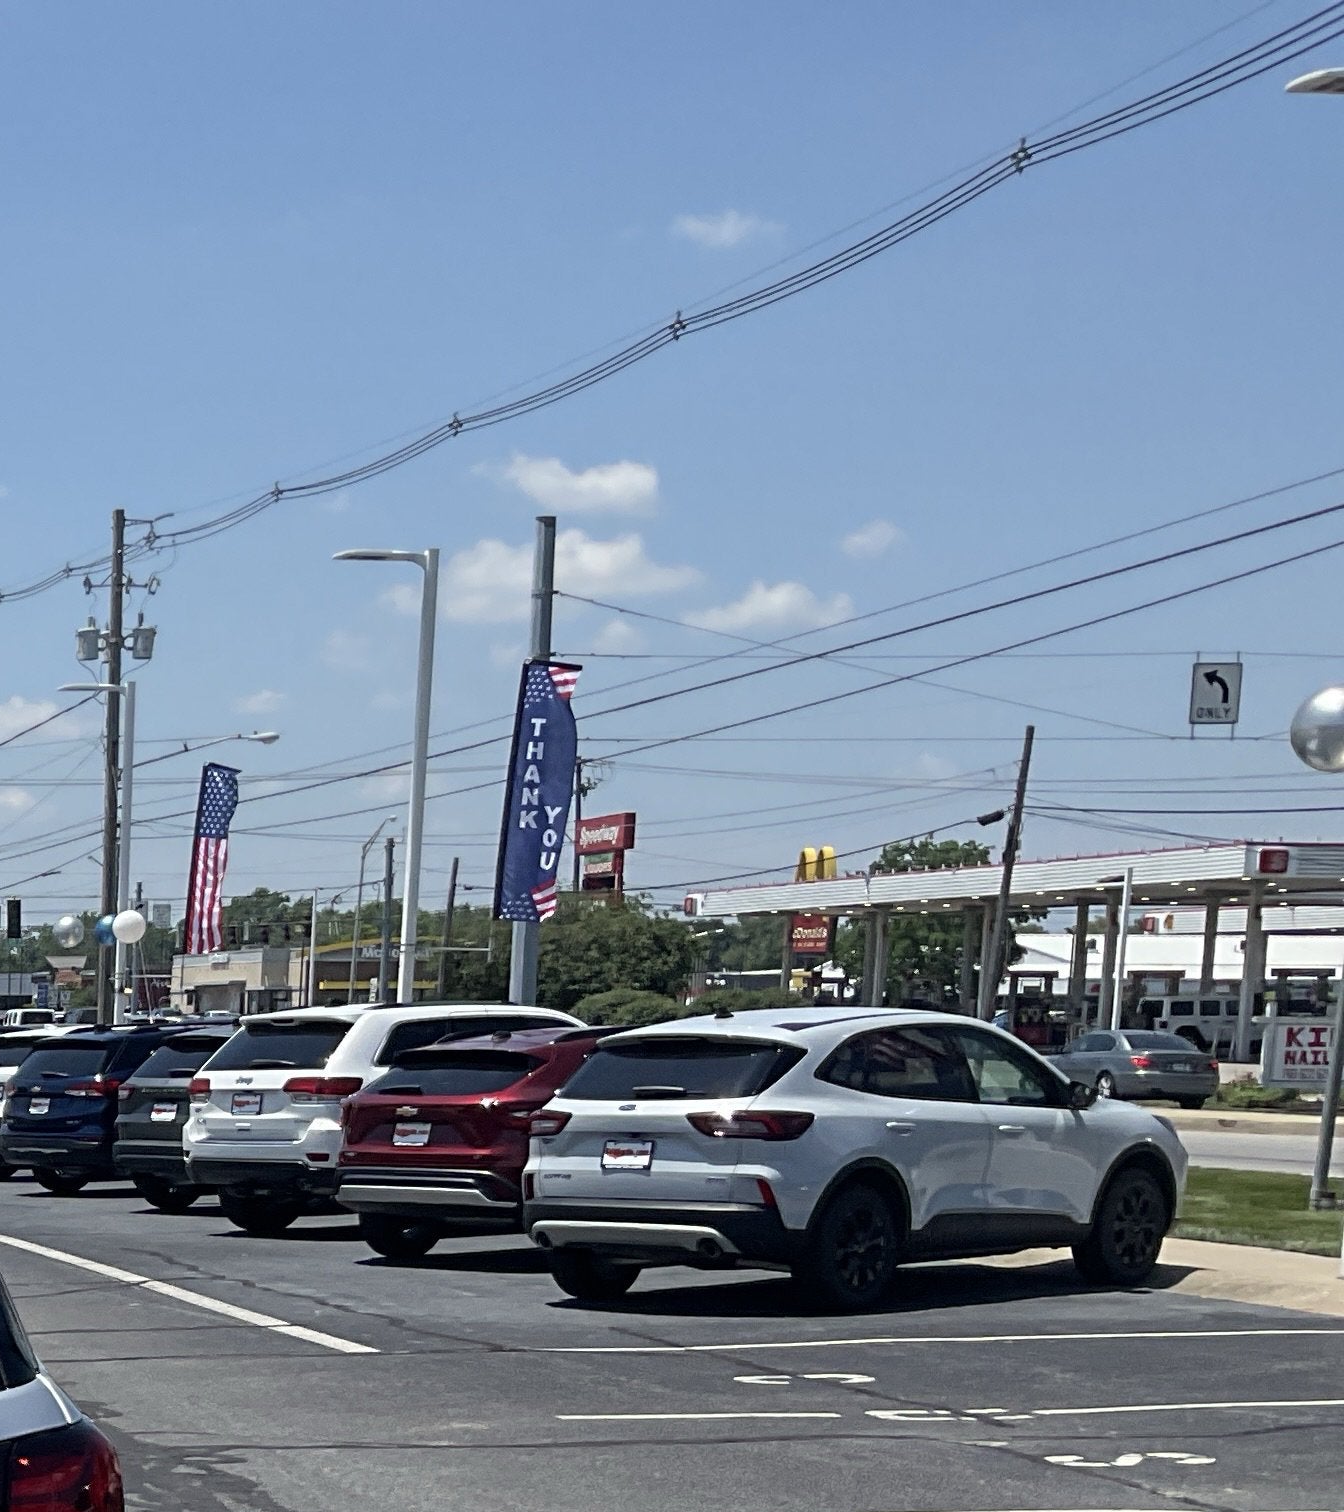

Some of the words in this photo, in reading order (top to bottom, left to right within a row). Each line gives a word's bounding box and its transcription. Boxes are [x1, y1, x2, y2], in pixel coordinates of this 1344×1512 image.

[1196, 706, 1231, 719] ONLY
[519, 718, 547, 829] THANK
[539, 805, 562, 871] YOU
